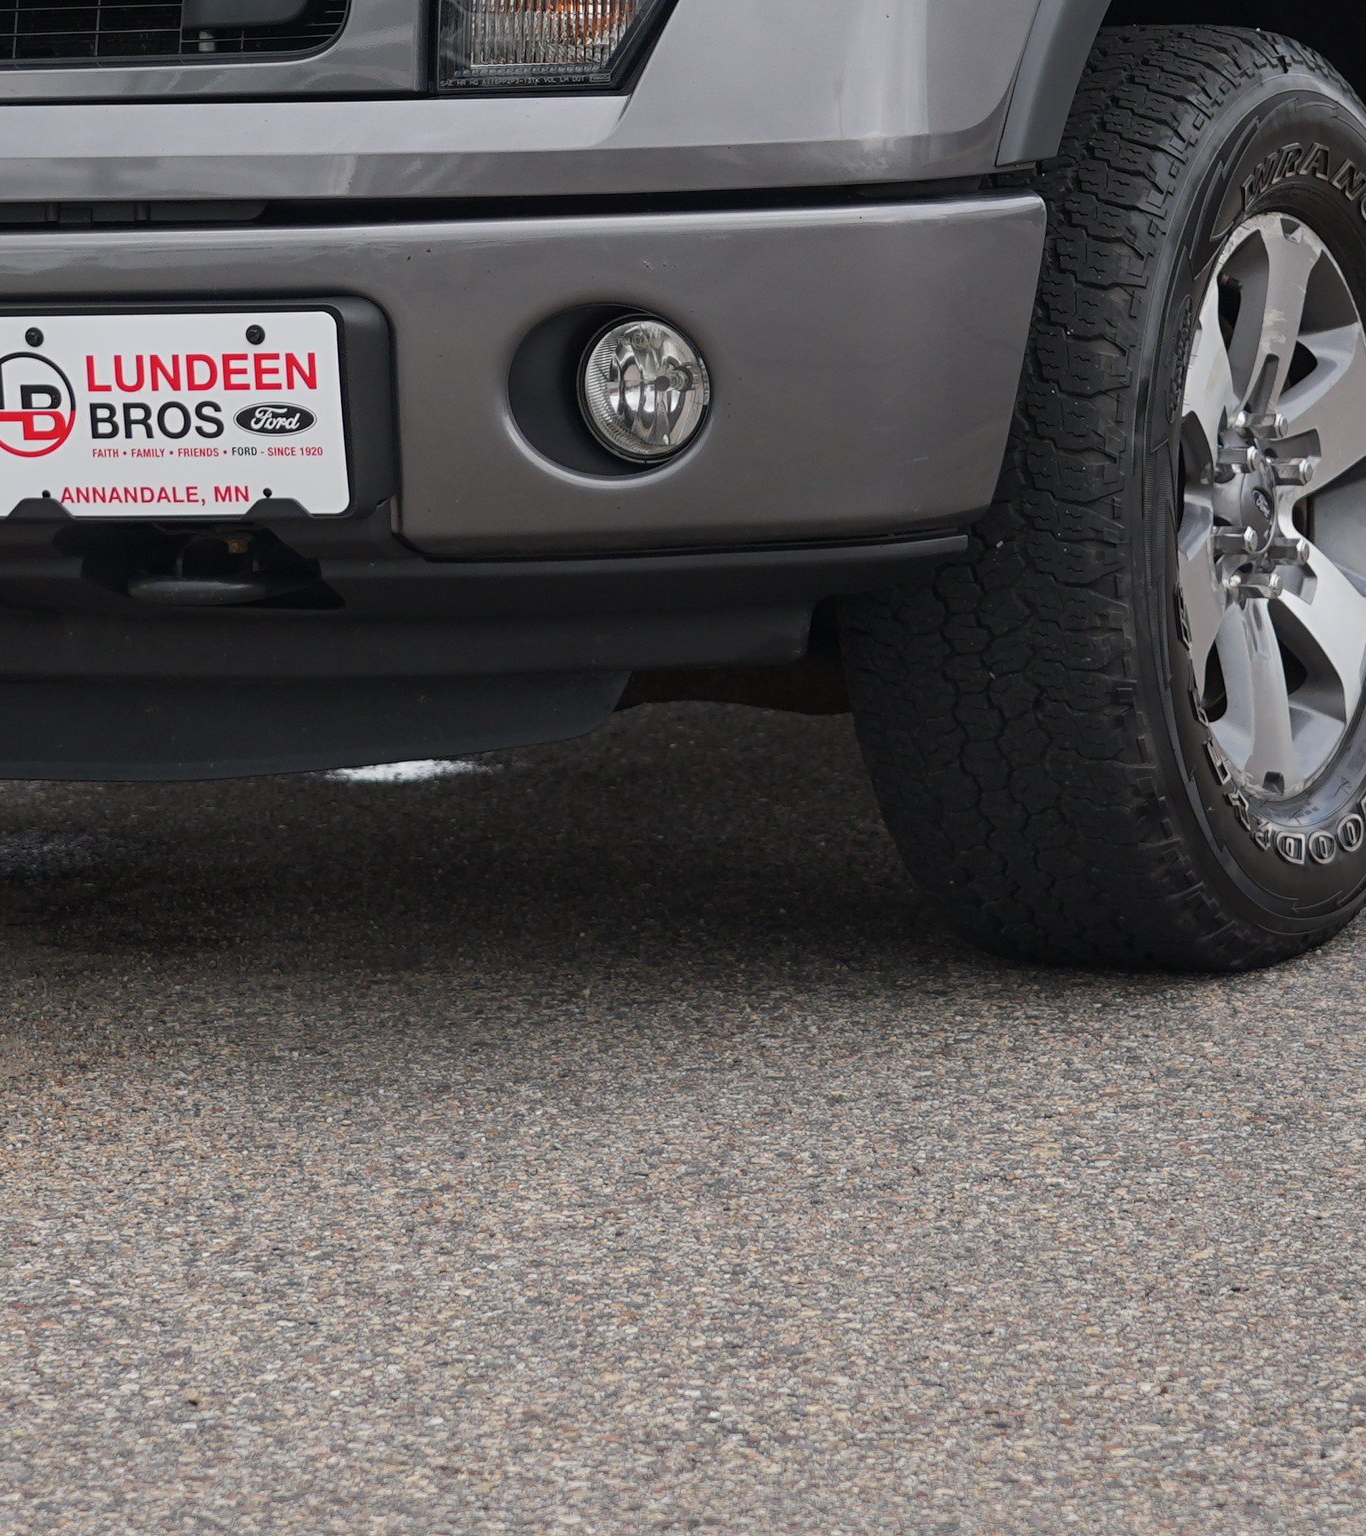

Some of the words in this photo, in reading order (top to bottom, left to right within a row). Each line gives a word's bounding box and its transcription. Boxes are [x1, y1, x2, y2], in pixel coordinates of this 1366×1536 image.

[86, 352, 318, 393] LUNDEEN
[89, 400, 225, 440] BROS
[250, 406, 300, 430] Ford
[92, 448, 120, 458] FAITH
[131, 447, 166, 458] FAMILY
[178, 447, 220, 457] FRIENDS
[231, 446, 258, 457] FORD
[267, 446, 297, 457] SINCE
[300, 446, 324, 457] 1920
[61, 486, 206, 506] ANNANDALE,
[214, 485, 250, 503] MN
